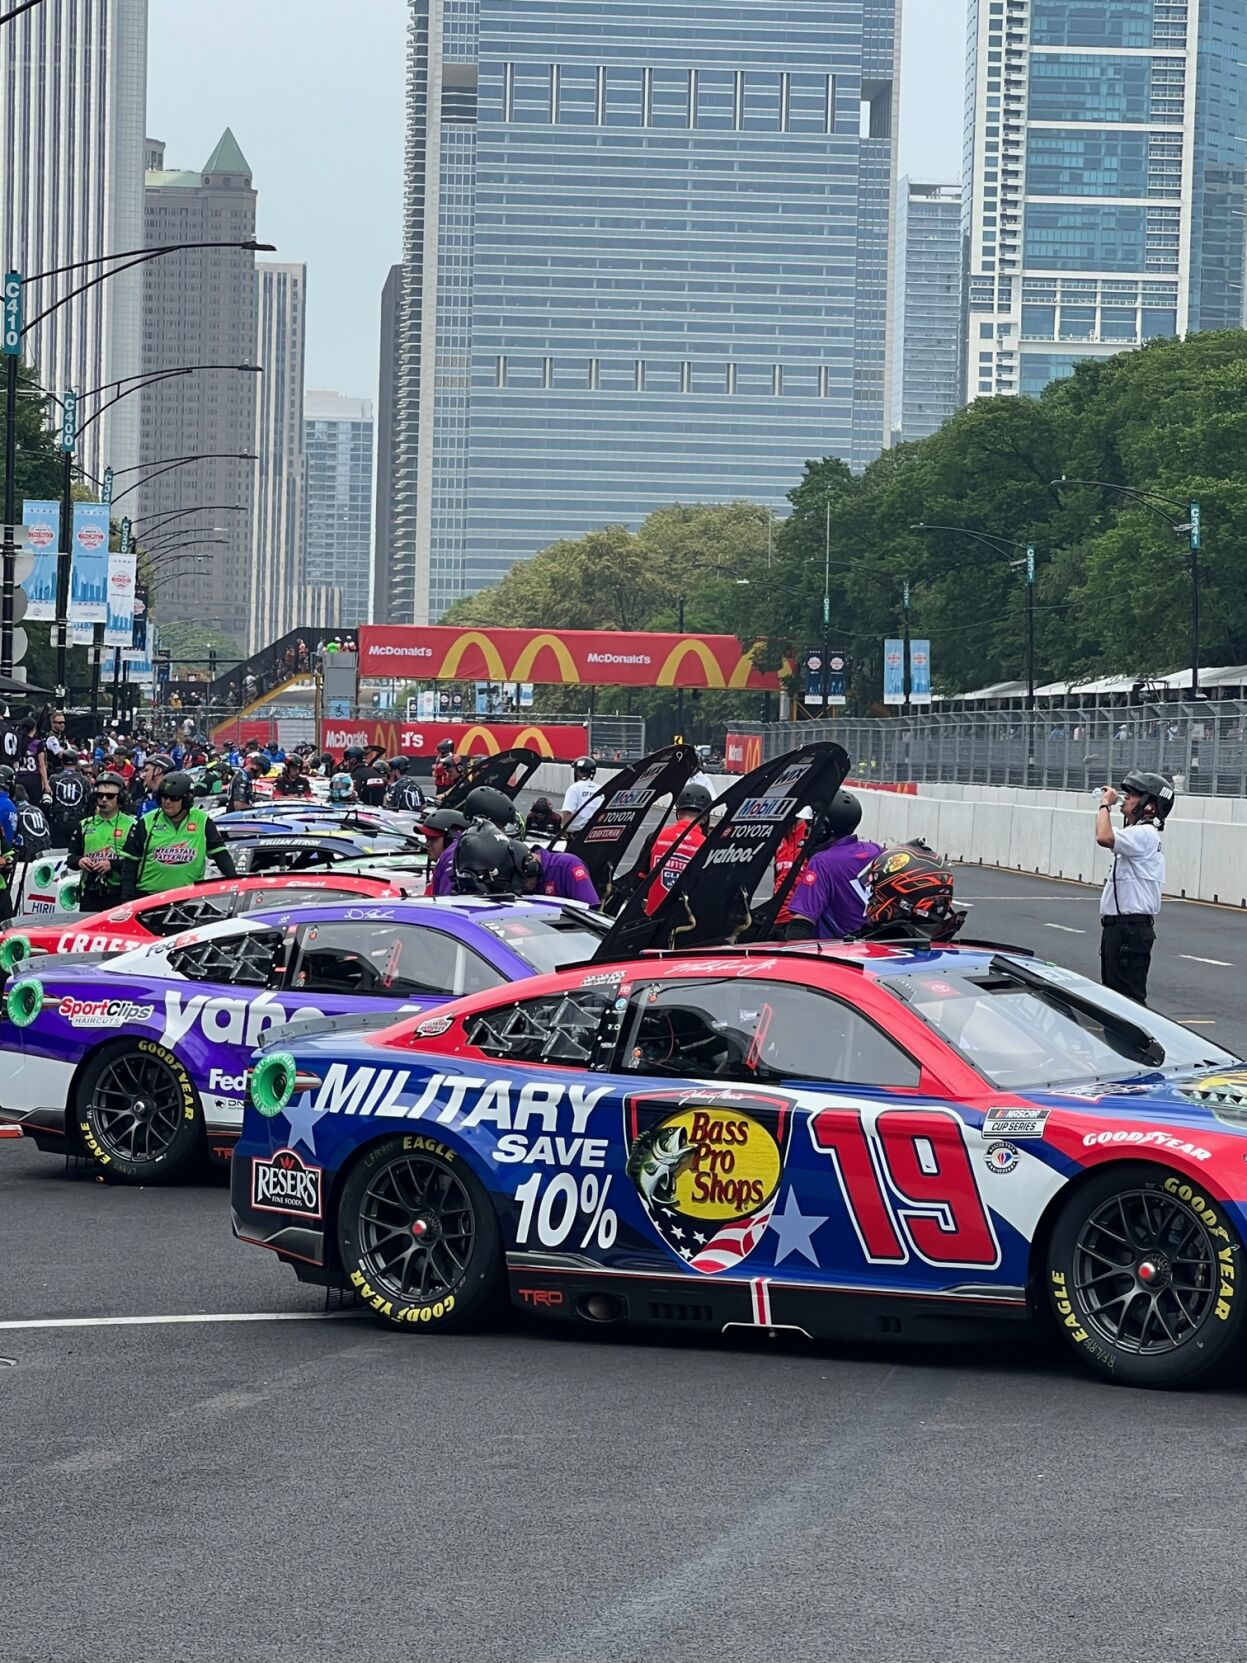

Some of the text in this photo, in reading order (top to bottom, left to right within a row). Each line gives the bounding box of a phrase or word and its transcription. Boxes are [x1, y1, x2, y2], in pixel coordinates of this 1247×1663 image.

[5, 281, 20, 346] C410
[63, 399, 75, 446] C400
[1191, 508, 1200, 544] C341
[368, 646, 433, 657] McDonald's
[587, 653, 651, 664] McDonald's
[325, 730, 369, 748] McDonald's
[603, 811, 636, 823] TOYOTA
[740, 799, 777, 816] Mobil
[588, 828, 622, 839] CRAFTSMAN
[730, 825, 774, 838] TOYOTA
[702, 842, 766, 869] yahoo!
[56, 932, 150, 953] CRAFT
[74, 1016, 121, 1025] HAIRCUTS
[138, 1040, 195, 1120] GOODYEAR
[314, 1063, 616, 1133] MILITARY
[688, 1112, 749, 1146] Bass
[991, 1122, 1036, 1131] CUP SERIES
[1005, 1110, 1041, 1118] NASCAR
[80, 1122, 112, 1165] EAGLE
[403, 1136, 458, 1162] EAGLE
[492, 1134, 608, 1168] SAVE
[689, 1143, 735, 1174] Pro
[1083, 1131, 1212, 1161] GOODYEAR
[257, 1165, 317, 1208] RESER'S
[272, 1195, 303, 1206] FINE FOODS
[691, 1171, 764, 1212] Shops
[808, 1107, 1000, 1269] 19
[514, 1172, 618, 1250] 10%
[1164, 1177, 1235, 1321] GOODYEAR
[350, 1270, 455, 1322] GOODYEAR
[518, 1289, 563, 1307] TRD
[1051, 1270, 1089, 1342] EAGLE
